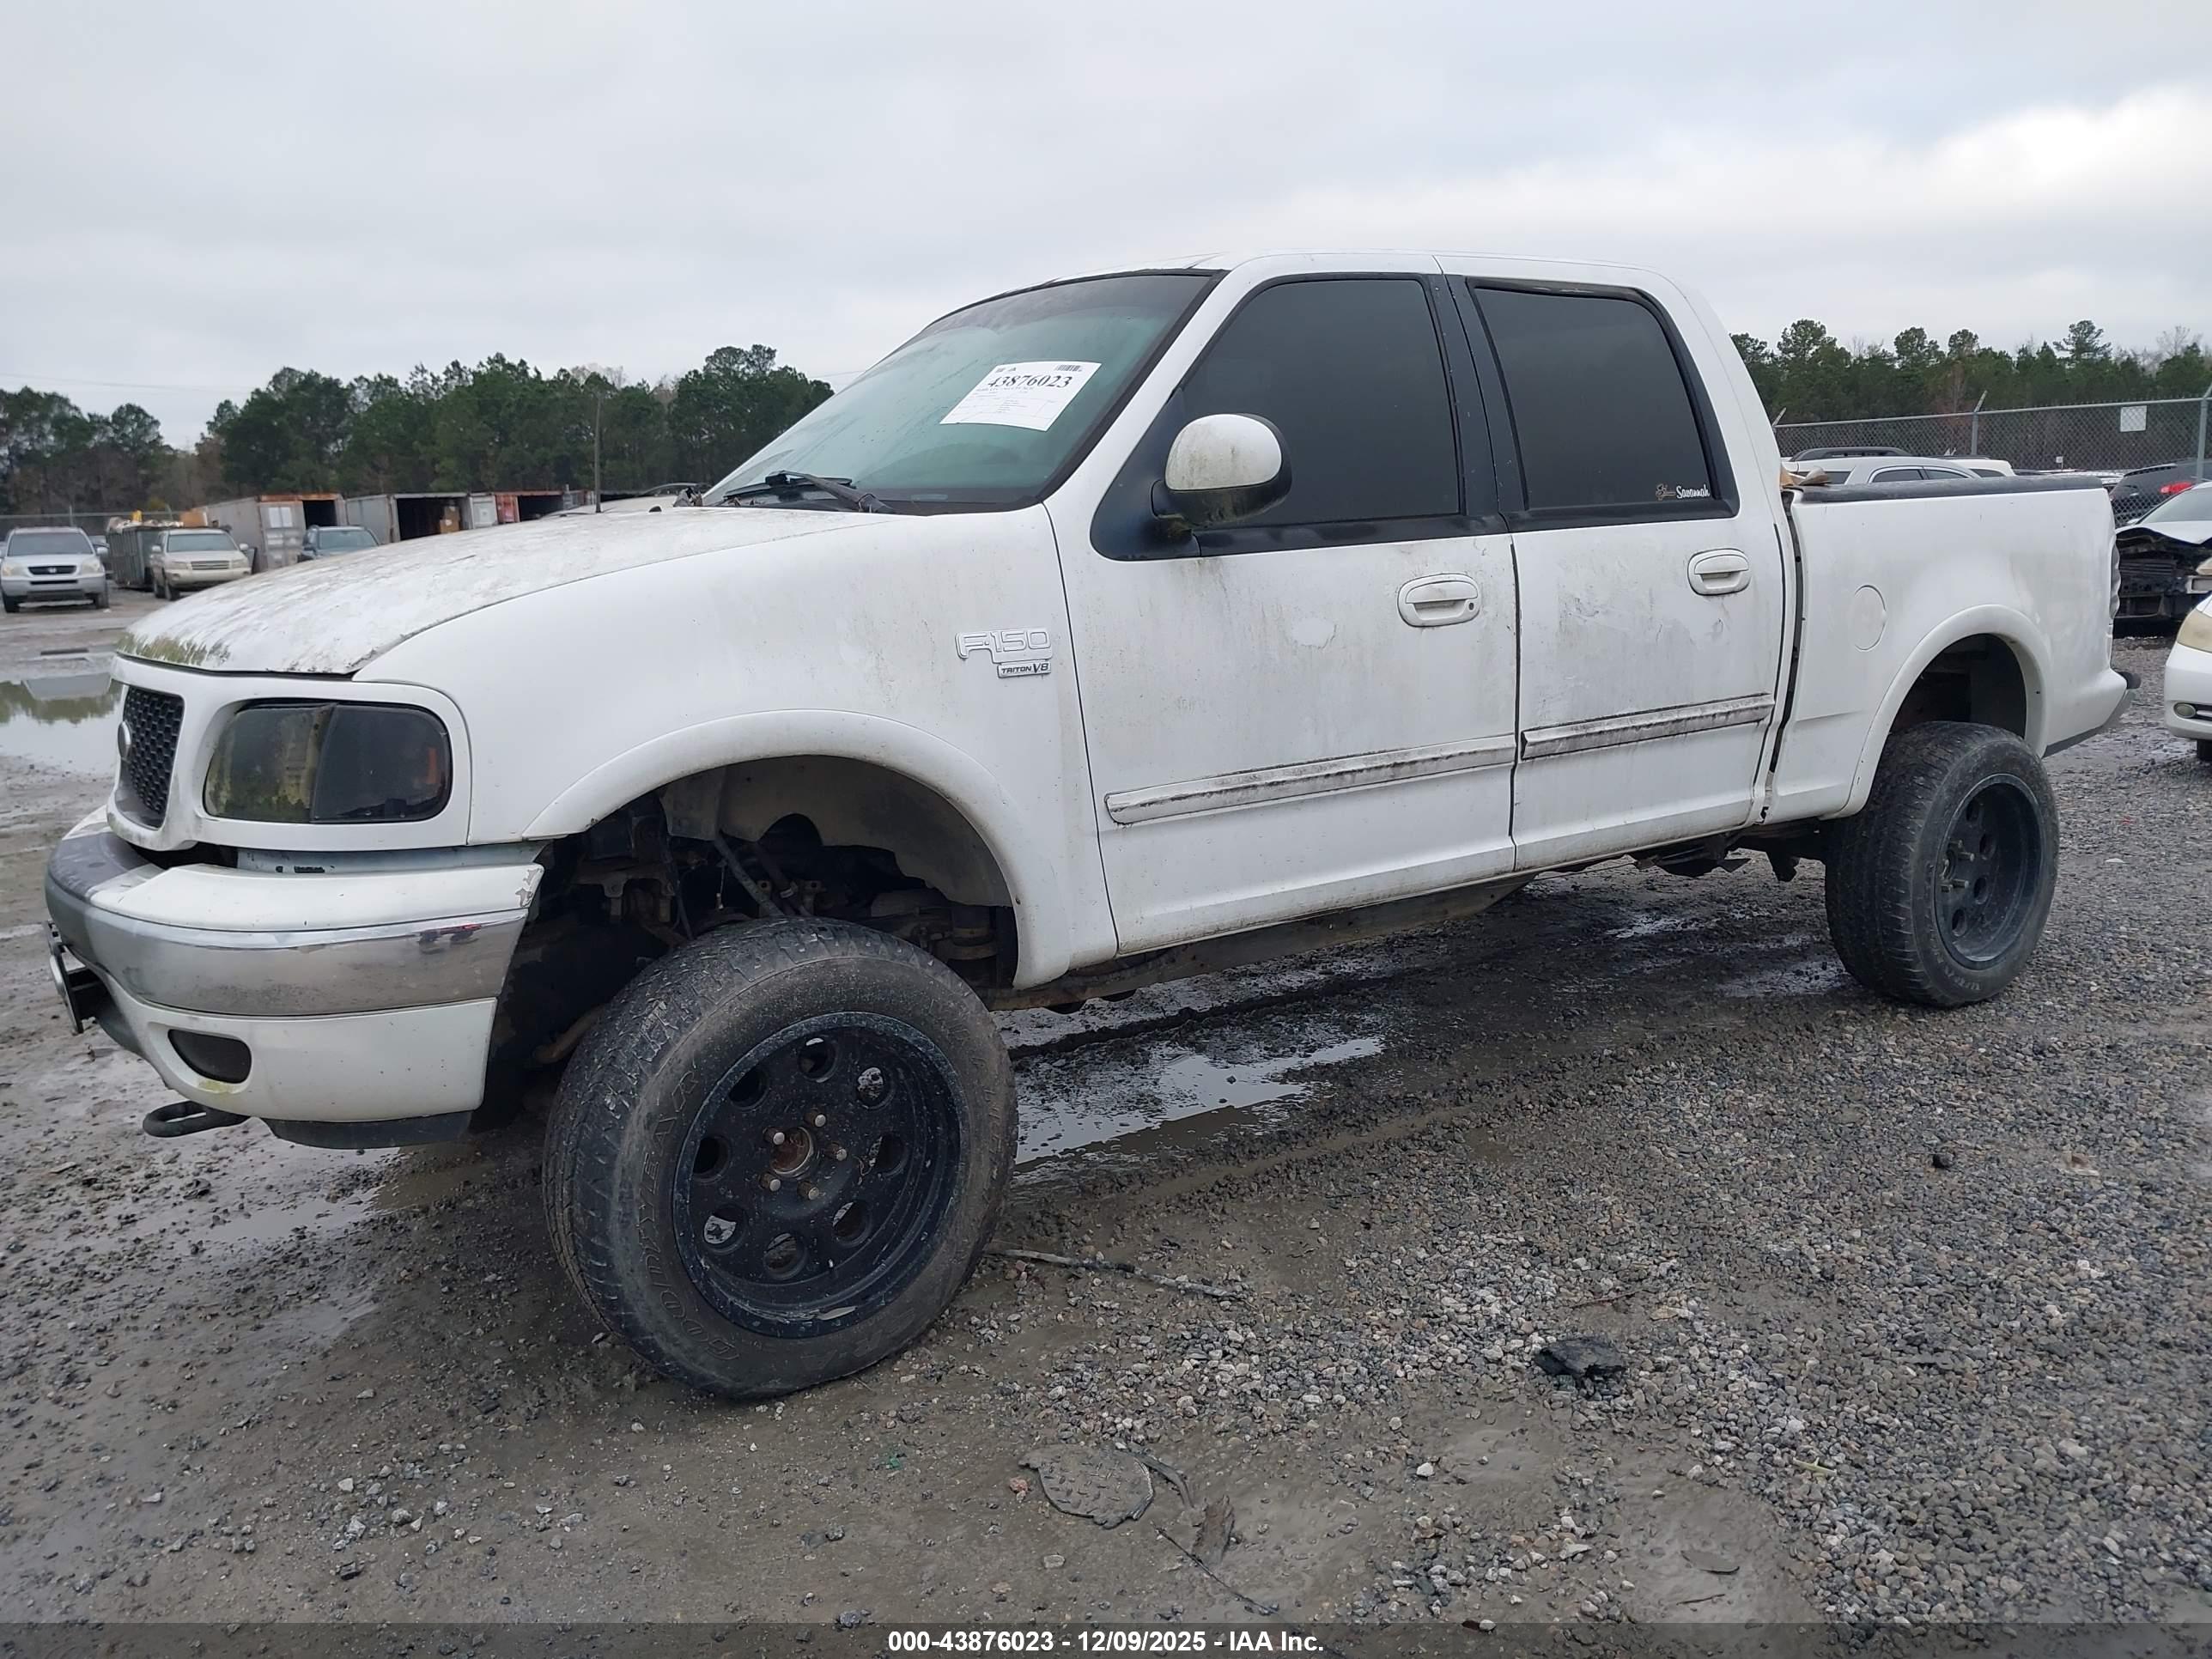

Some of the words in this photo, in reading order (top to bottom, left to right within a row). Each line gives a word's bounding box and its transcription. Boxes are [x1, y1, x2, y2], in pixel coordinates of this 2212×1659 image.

[988, 374, 1073, 388] 43876023
[1033, 663, 1049, 673] V8
[638, 1070, 740, 1361] GOODYEAR
